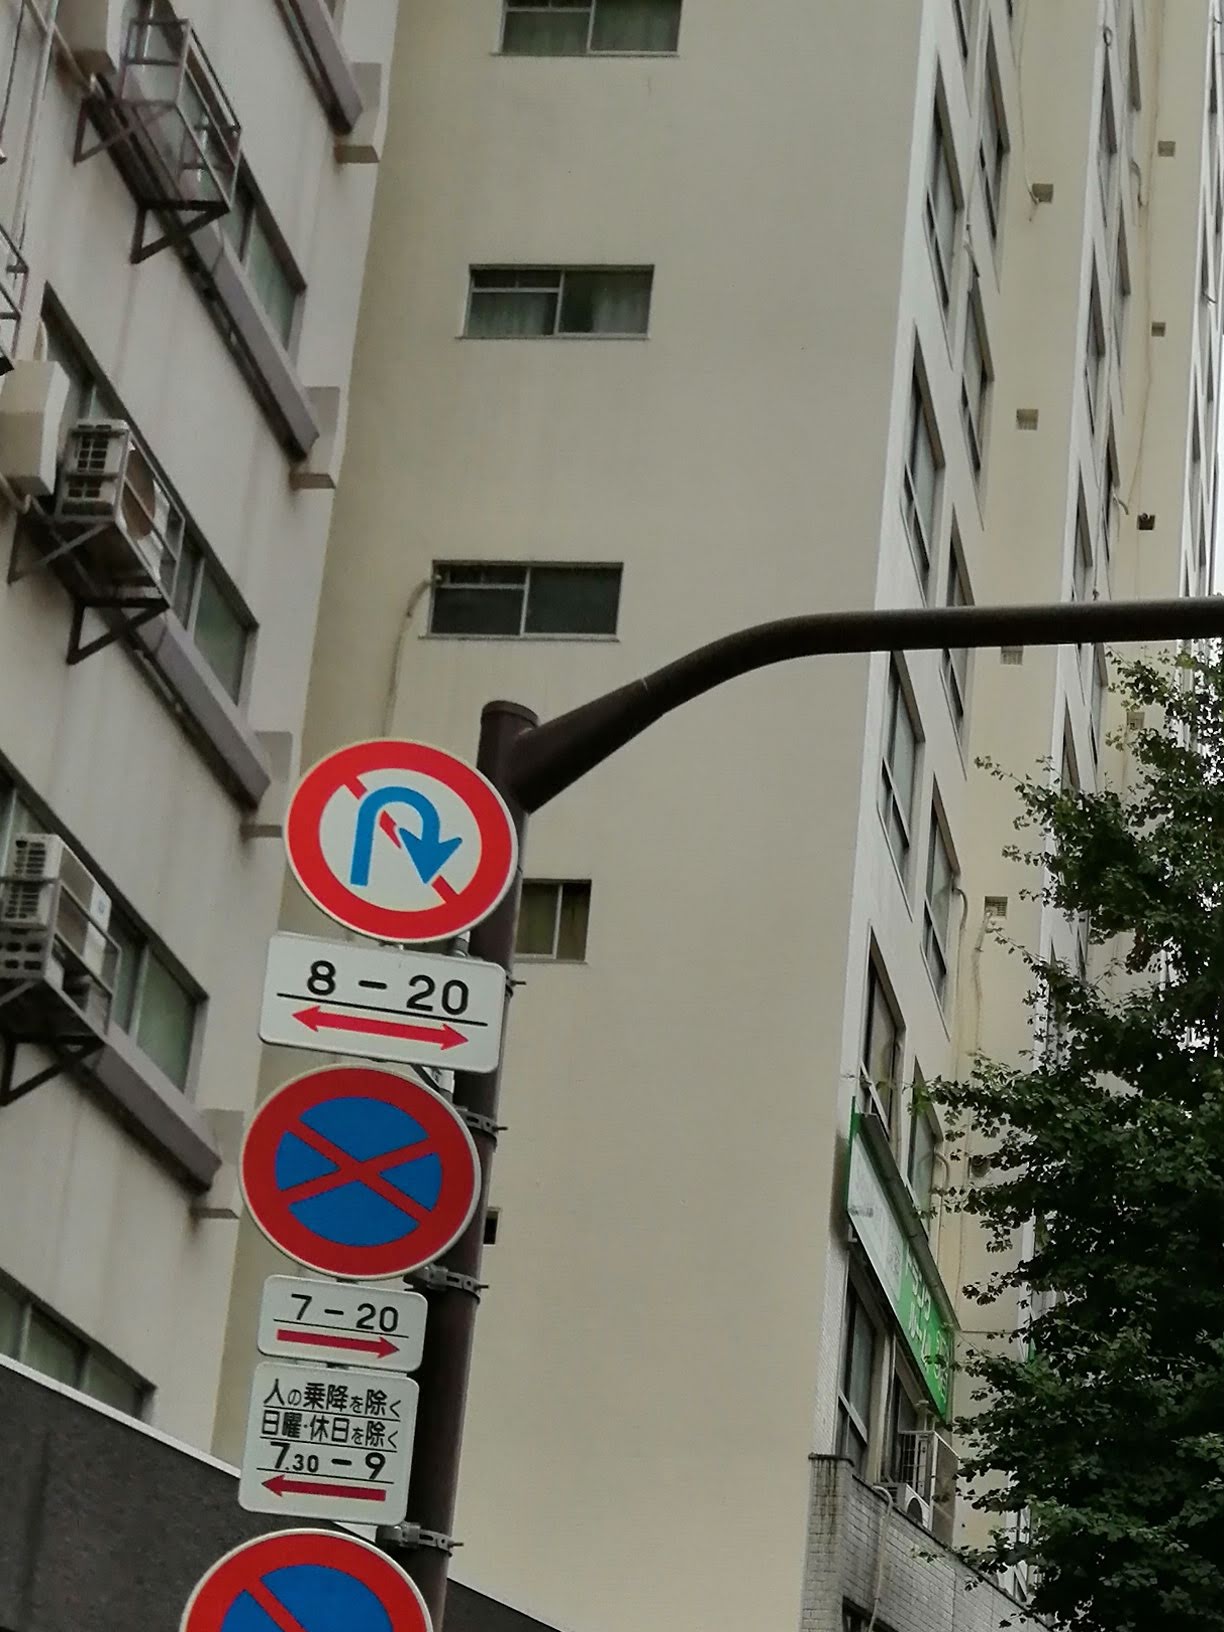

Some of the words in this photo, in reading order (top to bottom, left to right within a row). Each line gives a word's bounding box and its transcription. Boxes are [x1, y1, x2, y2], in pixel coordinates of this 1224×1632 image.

[263, 1378, 401, 1418] 人の乗降を除く
[261, 1409, 398, 1449] 日曜・休日を除く
